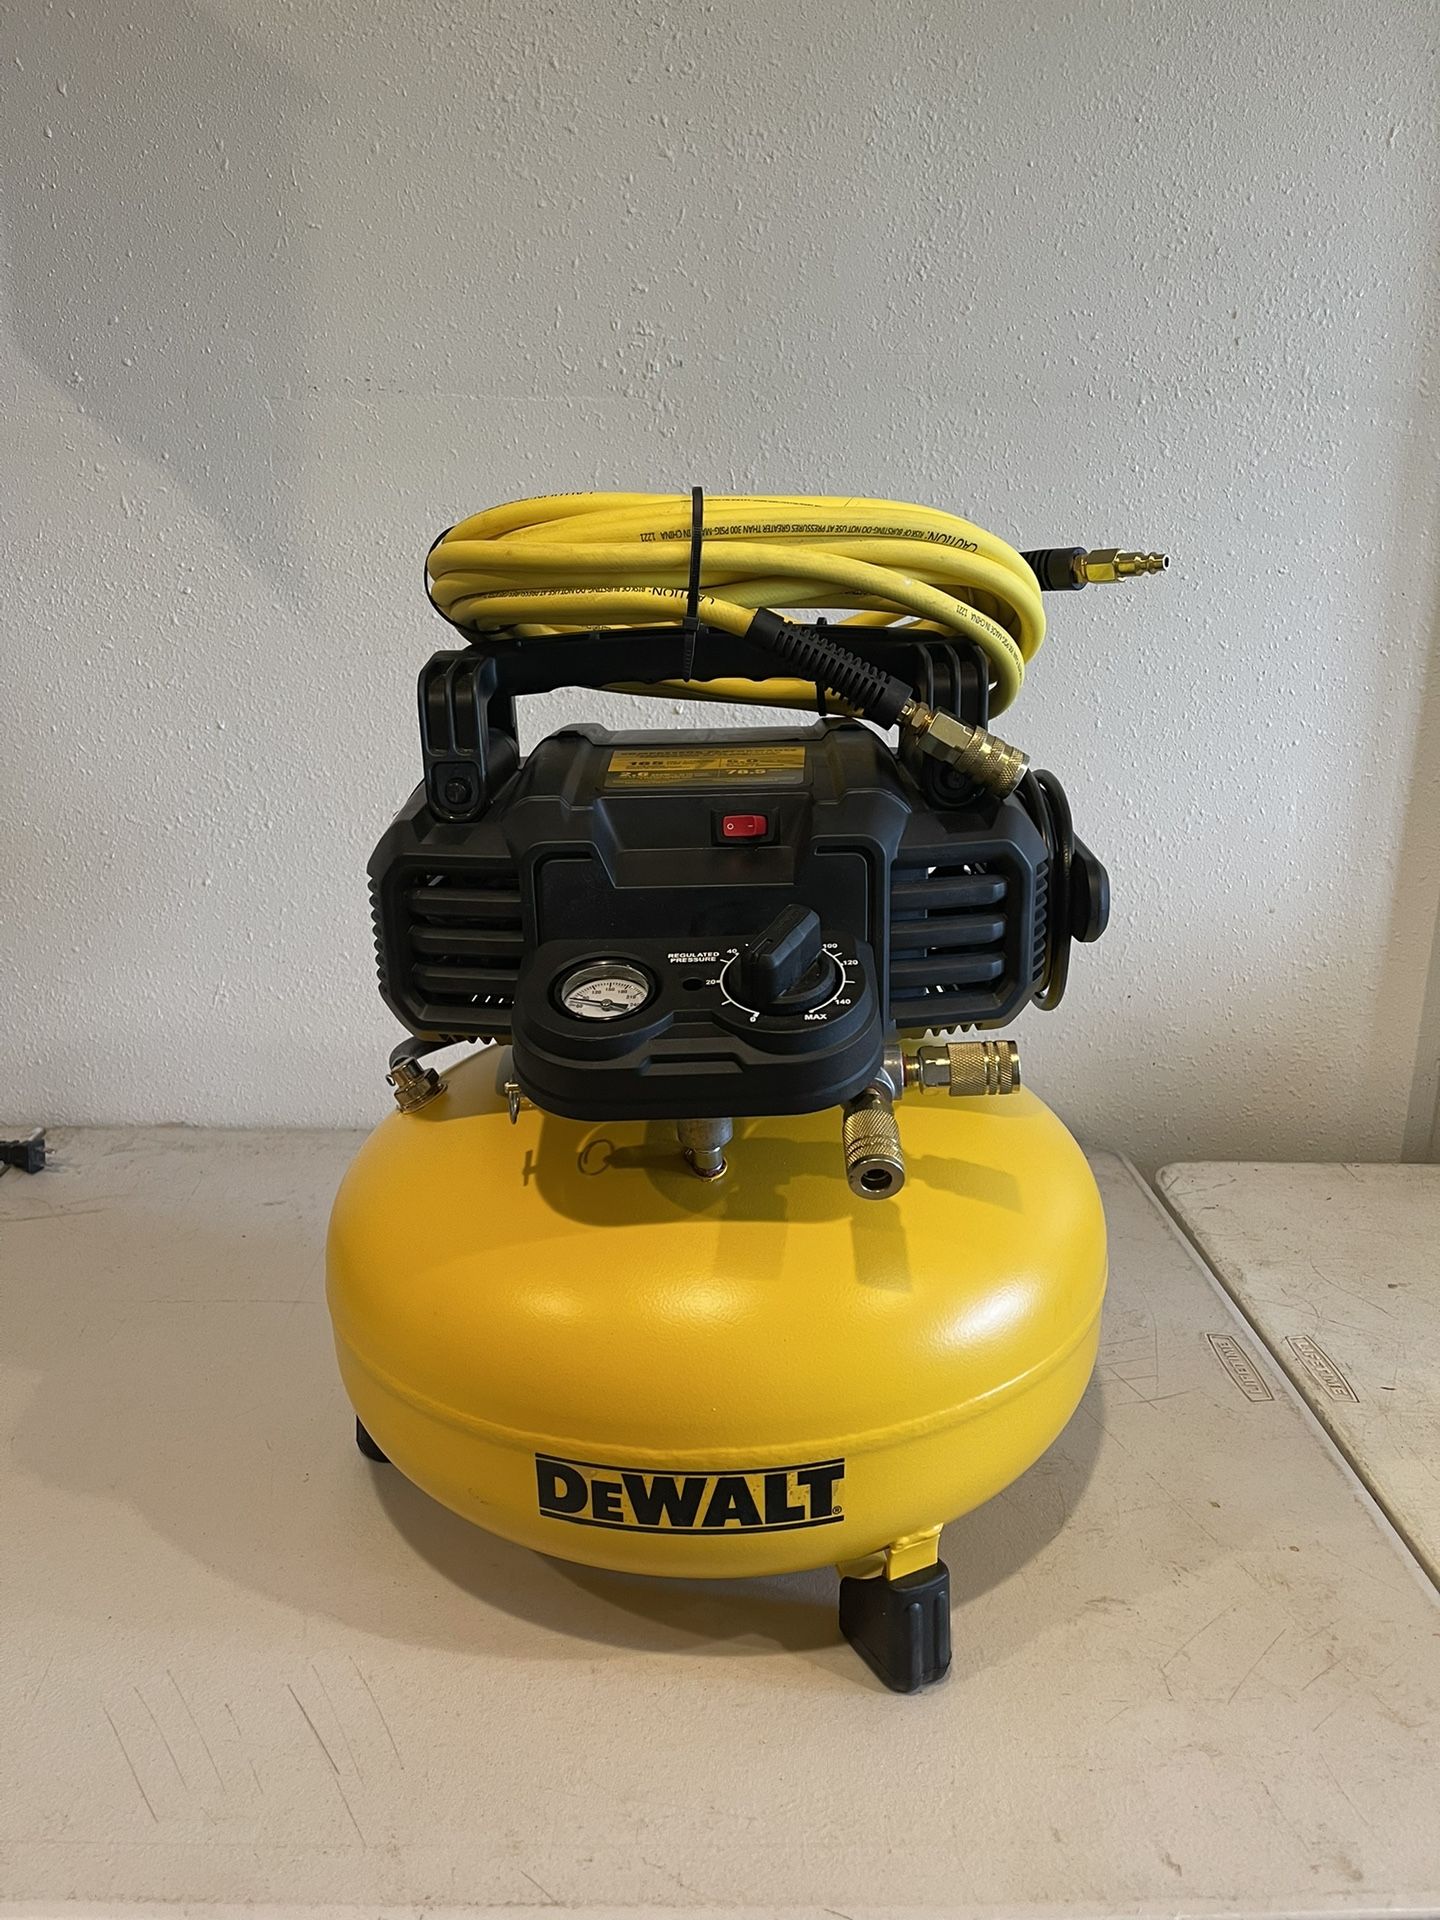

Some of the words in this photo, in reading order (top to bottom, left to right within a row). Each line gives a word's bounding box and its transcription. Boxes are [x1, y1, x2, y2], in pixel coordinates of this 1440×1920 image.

[729, 525, 742, 535] 300
[742, 524, 761, 535] THAN
[762, 523, 791, 534] GREATER
[791, 523, 826, 533] PRESSURES
[825, 524, 835, 533] AT
[834, 524, 848, 534] USE
[847, 525, 862, 534] NOT
[640, 532, 656, 542] 1221
[660, 529, 683, 540] CHINA
[667, 951, 720, 959] REGULATED
[804, 1013, 828, 1021] MAX
[1217, 1341, 1263, 1395] LIFETIME
[1294, 1340, 1348, 1396] LIFETIME
